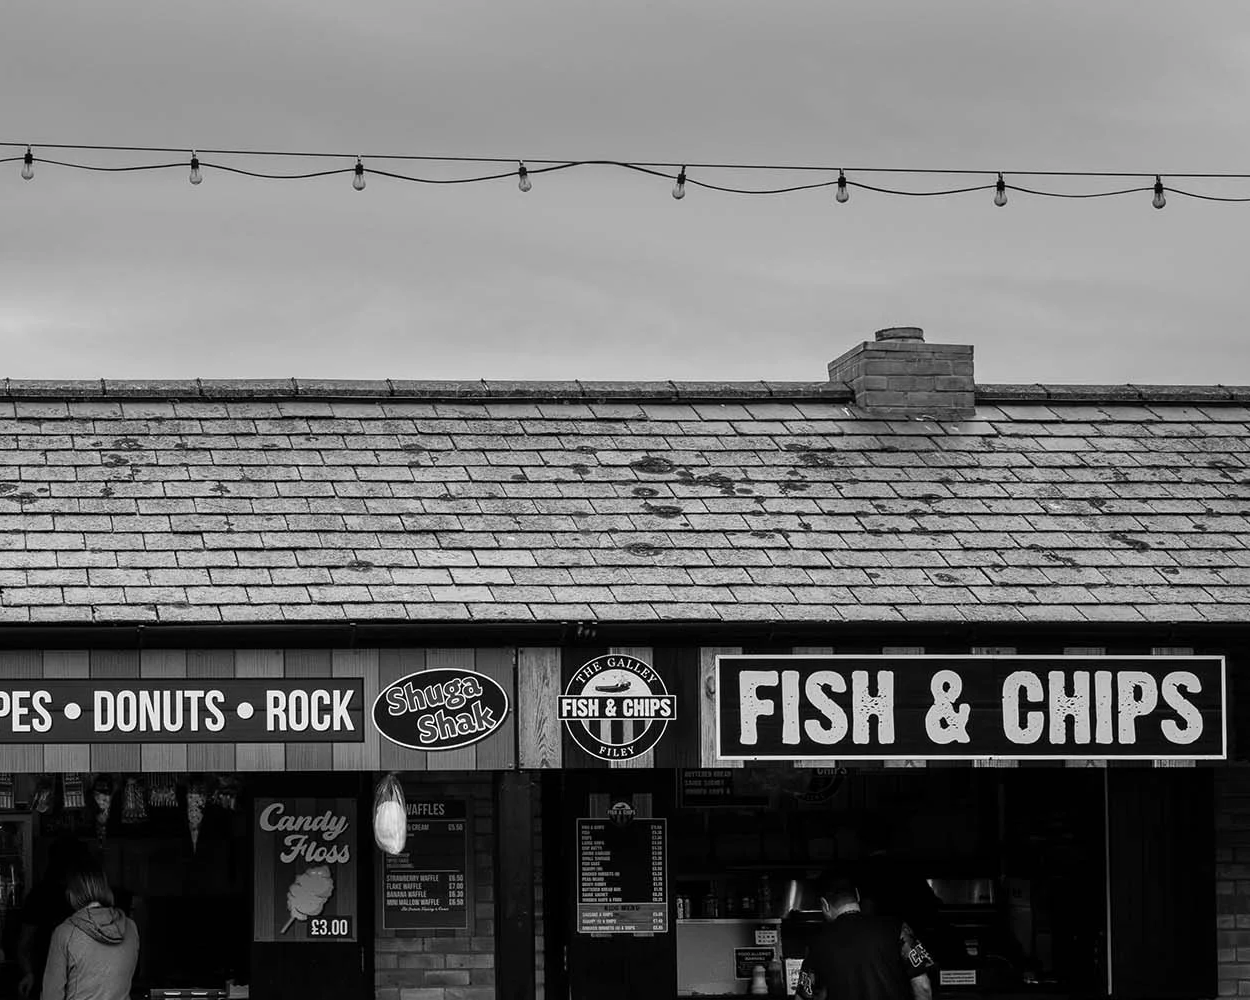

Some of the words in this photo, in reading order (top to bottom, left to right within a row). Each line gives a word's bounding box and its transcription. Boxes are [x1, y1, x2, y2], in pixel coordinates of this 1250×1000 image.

[576, 662, 602, 684] THE
[607, 657, 658, 684] GALLEY
[94, 690, 225, 732] DONUTS
[266, 690, 354, 731] ROCK
[386, 676, 483, 717] Shuga
[562, 698, 599, 718] FISH
[605, 698, 617, 718] &
[623, 698, 672, 718] CHIPS
[738, 670, 895, 745] FISH
[925, 670, 970, 745] &
[1002, 669, 1203, 745] CHIPS
[417, 702, 497, 743] Shak
[599, 745, 635, 758] FILEY
[259, 803, 349, 840] Candy
[280, 834, 350, 864] Floss
[311, 919, 348, 936] £3.00
